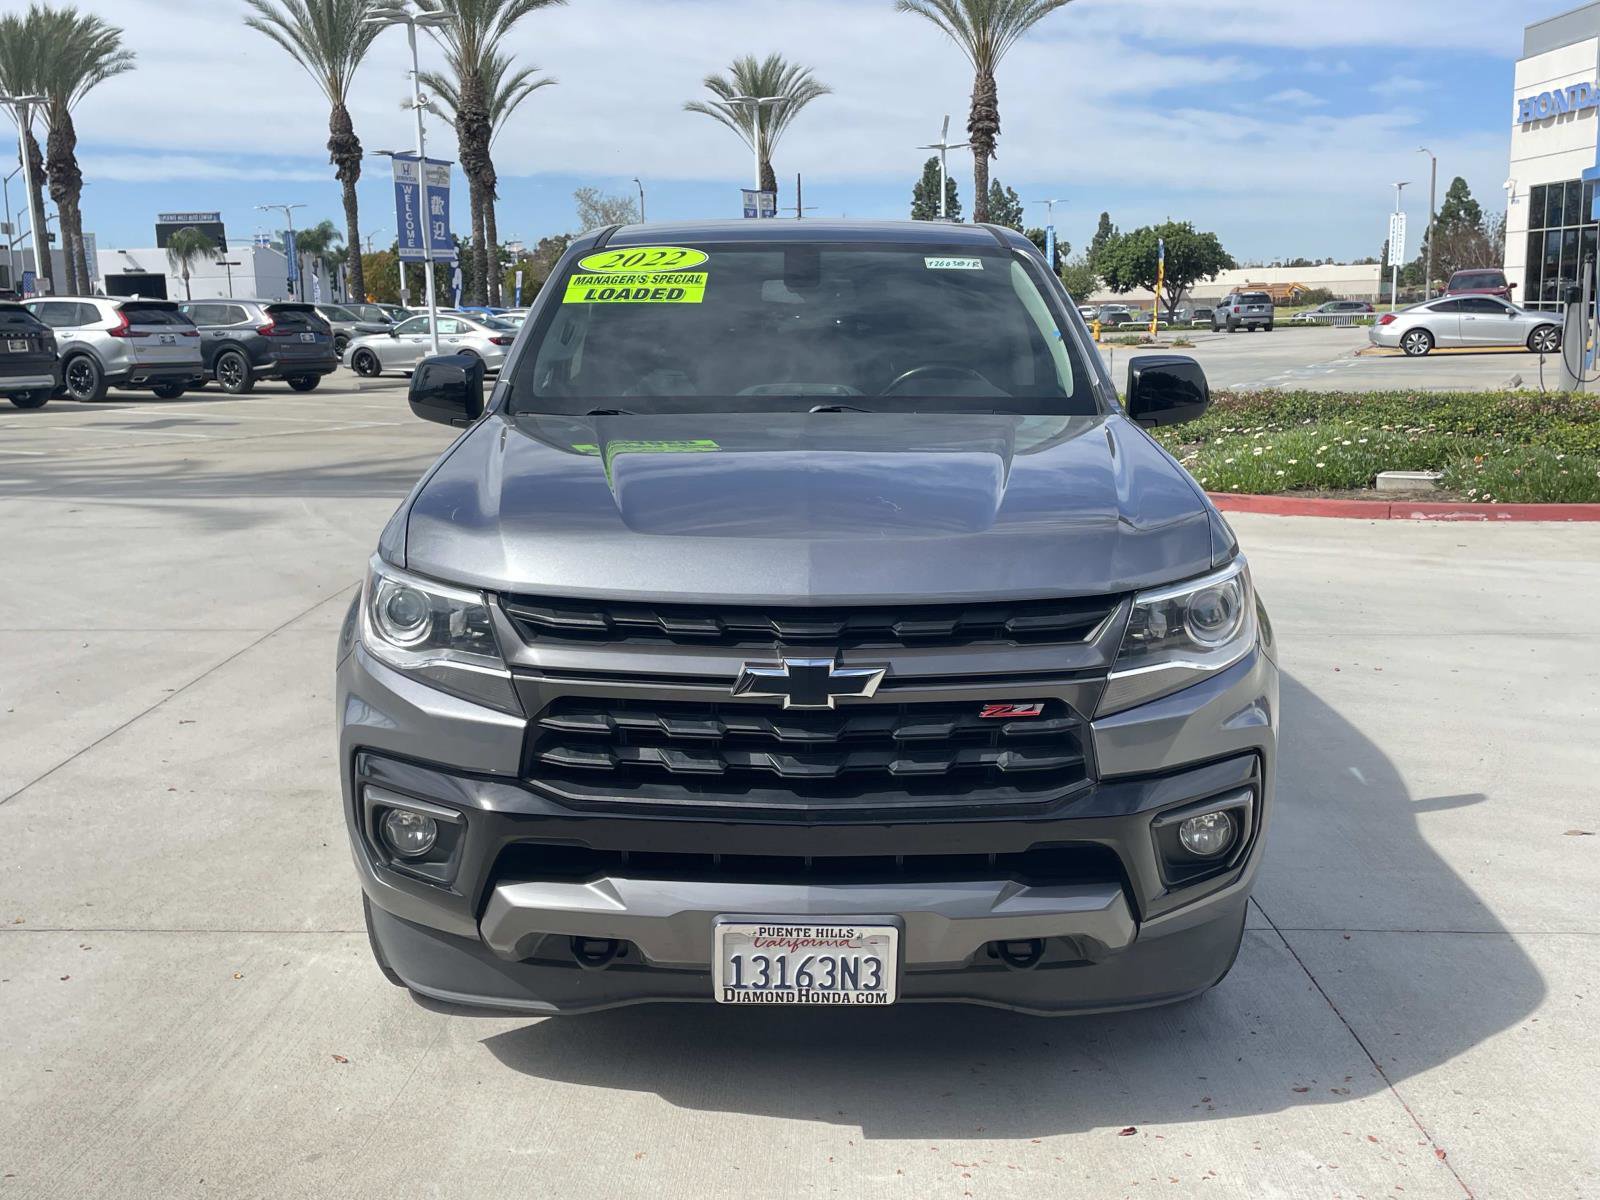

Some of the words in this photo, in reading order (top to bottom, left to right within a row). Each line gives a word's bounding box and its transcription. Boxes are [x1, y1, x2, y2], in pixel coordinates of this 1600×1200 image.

[402, 184, 416, 248] WELCOME
[600, 251, 688, 269] 2022
[573, 274, 648, 286] MANAGER'S
[650, 274, 704, 285] SPECIAL
[584, 288, 686, 302] LOADED
[758, 927, 811, 938] PUENTE
[815, 928, 855, 938] HILLS
[753, 937, 862, 953] California
[730, 955, 882, 991] 13163N3
